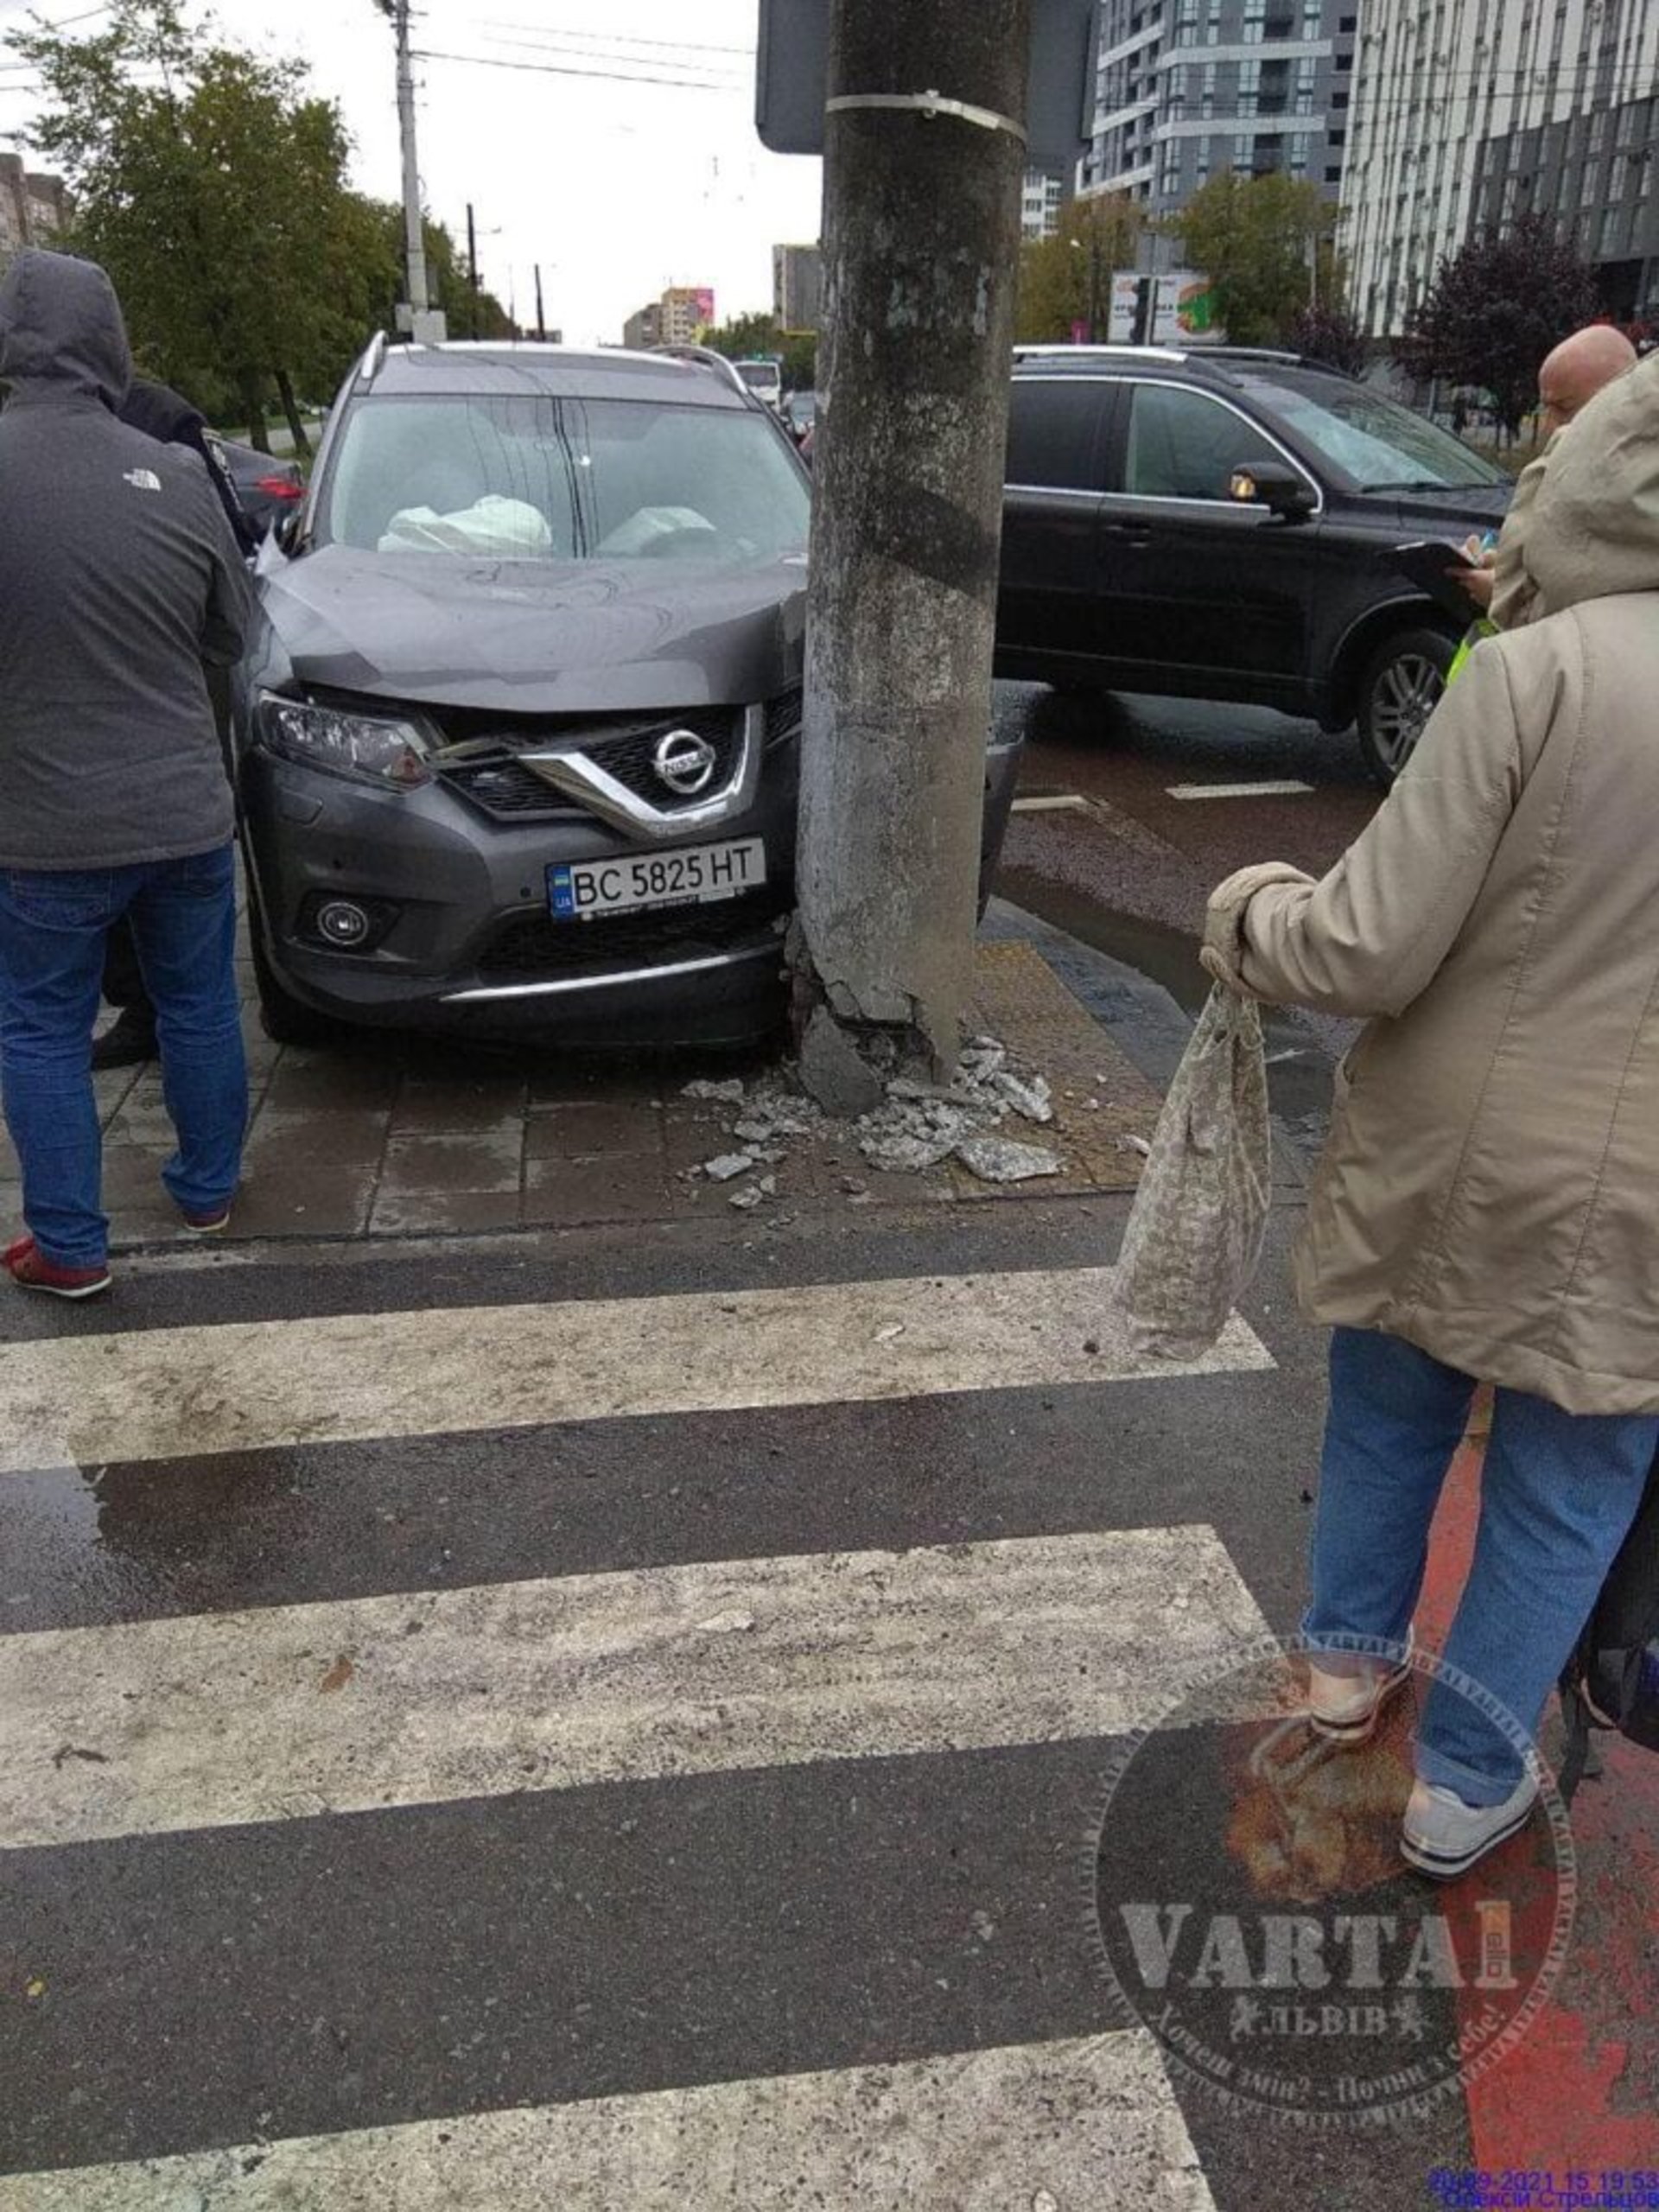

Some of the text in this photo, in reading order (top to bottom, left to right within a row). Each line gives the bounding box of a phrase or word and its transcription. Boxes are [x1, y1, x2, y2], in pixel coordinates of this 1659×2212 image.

[574, 846, 753, 906] BC 5825 HT
[555, 895, 572, 908] UA
